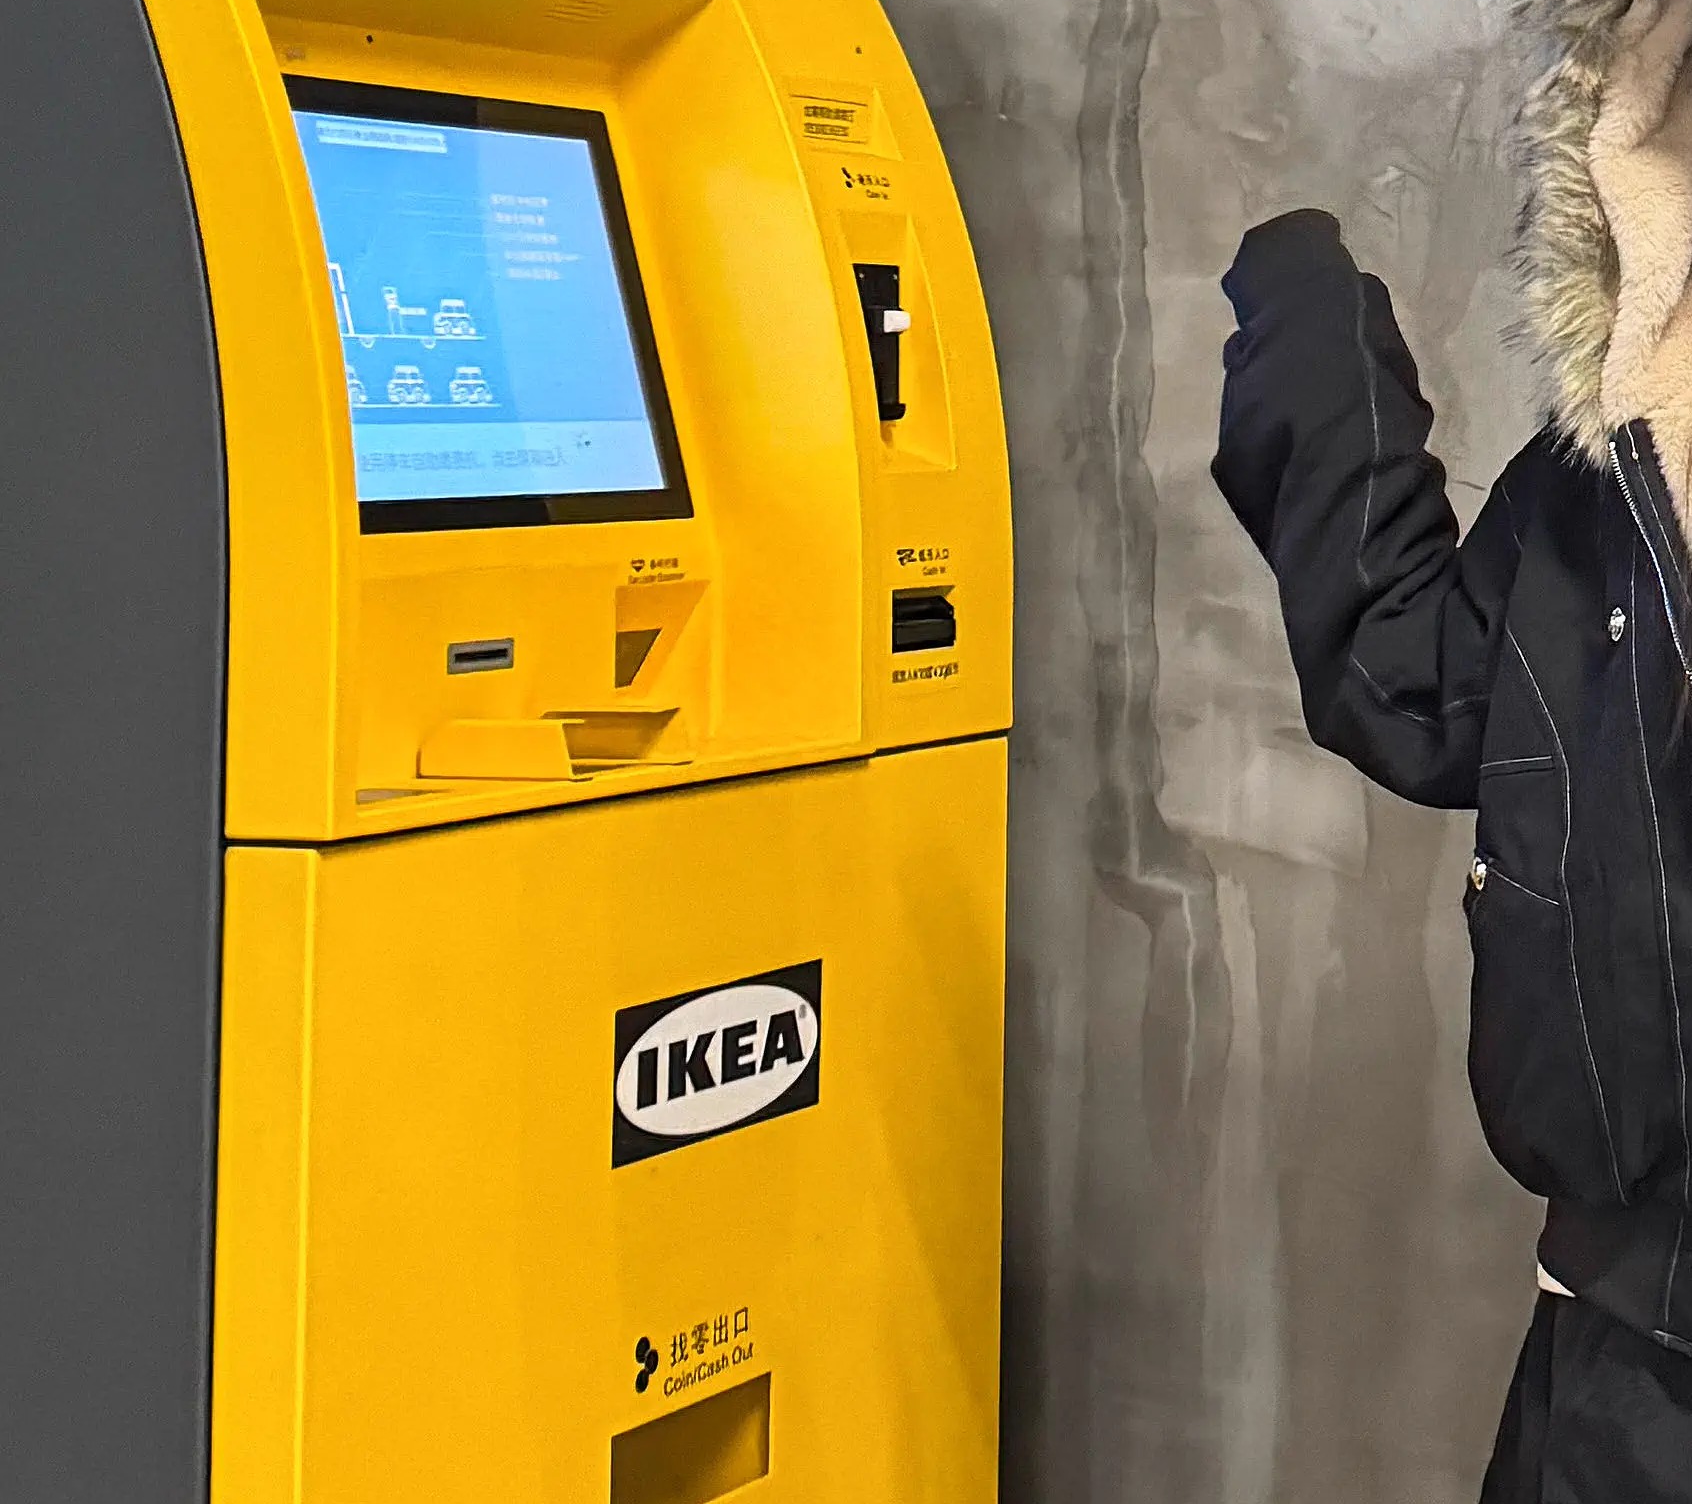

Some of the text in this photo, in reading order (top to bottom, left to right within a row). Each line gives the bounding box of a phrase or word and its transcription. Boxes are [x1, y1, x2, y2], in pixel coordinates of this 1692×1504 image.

[636, 1008, 806, 1112] IKEA
[669, 1306, 749, 1368] 找零出口
[663, 1342, 754, 1398] Coin/Cash Out
